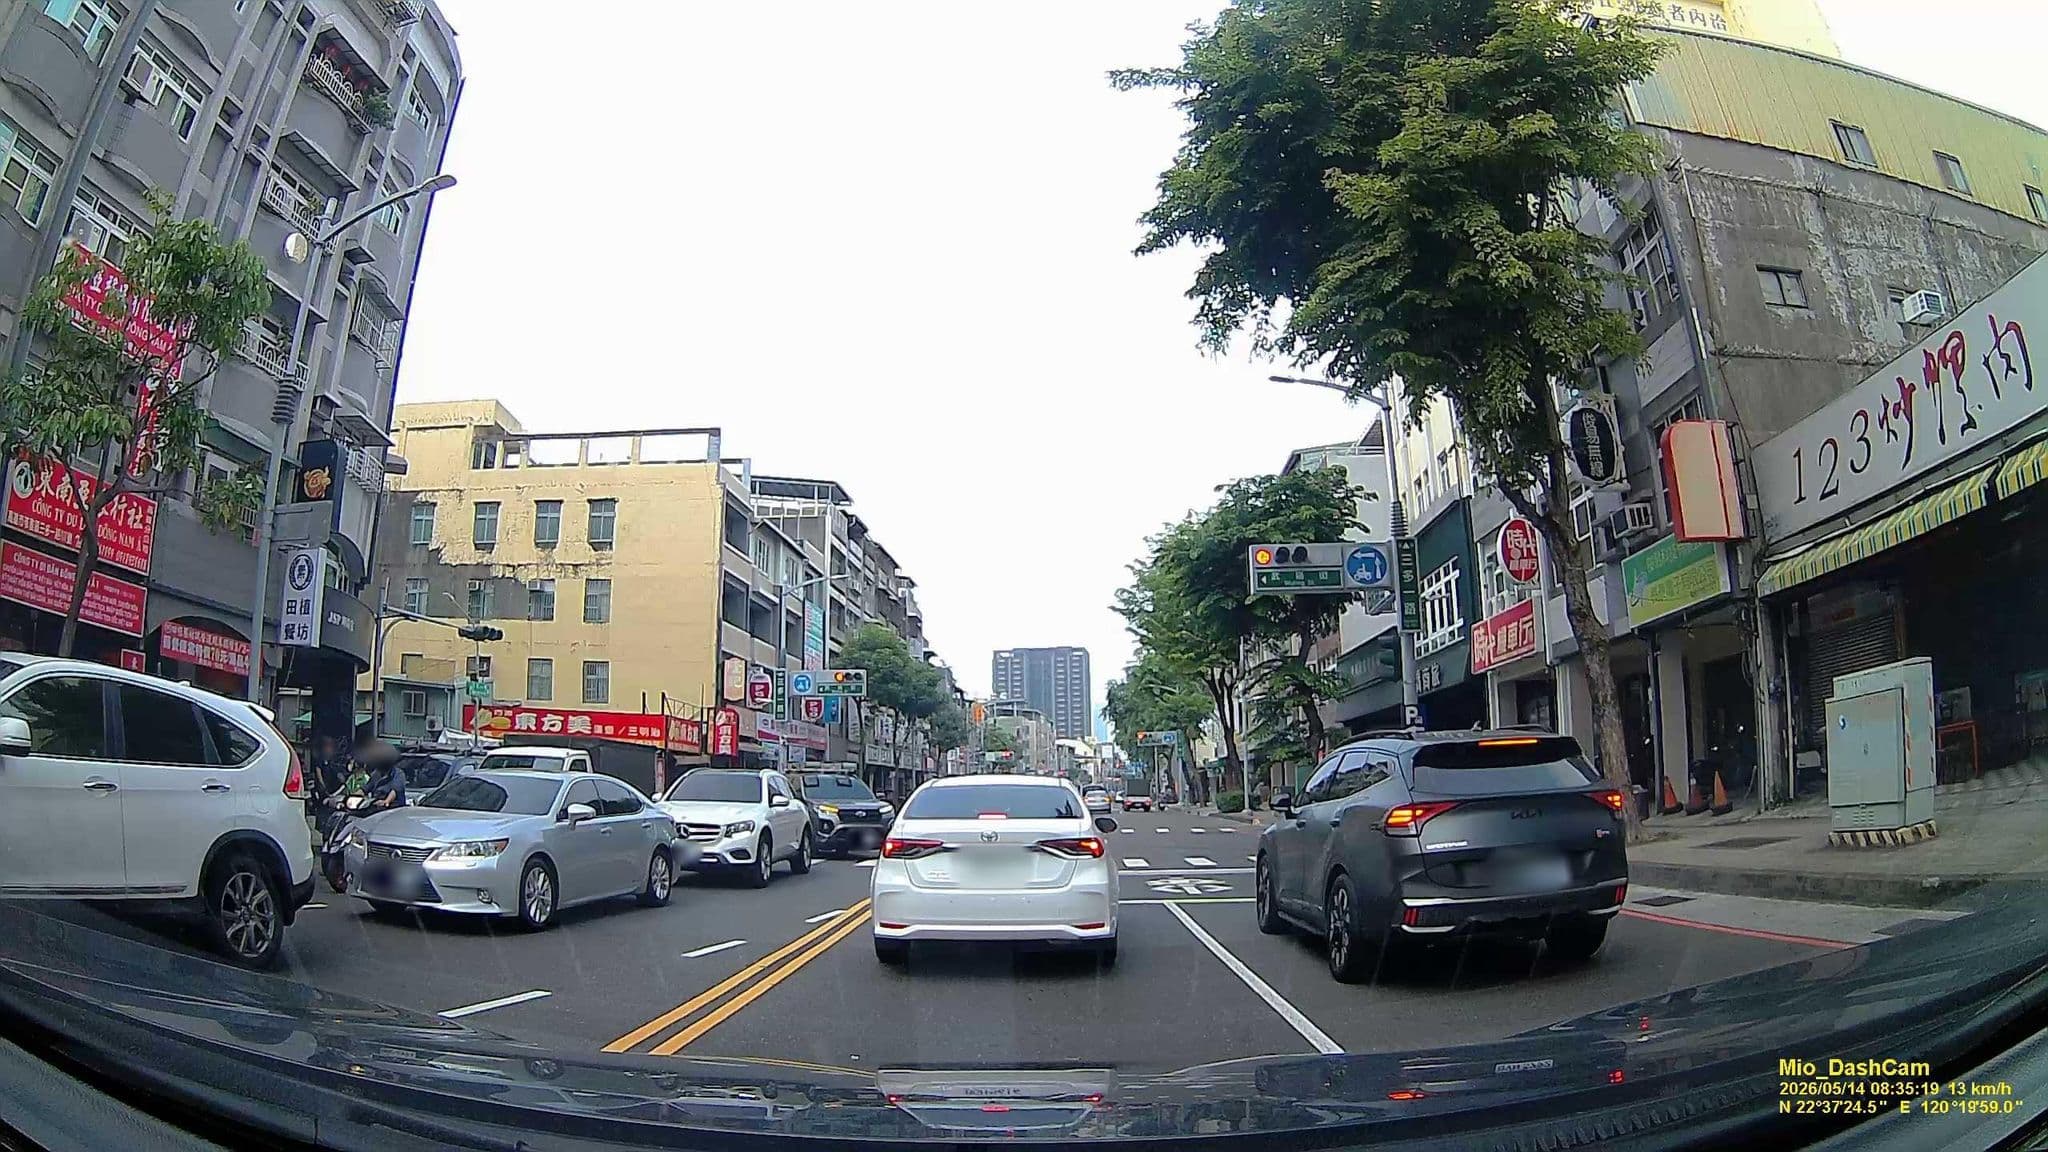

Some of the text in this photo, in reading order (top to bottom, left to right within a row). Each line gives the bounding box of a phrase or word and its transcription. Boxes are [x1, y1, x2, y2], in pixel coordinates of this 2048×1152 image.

[1401, 553, 1416, 616] 三多一路
[515, 713, 592, 734] 東方美
